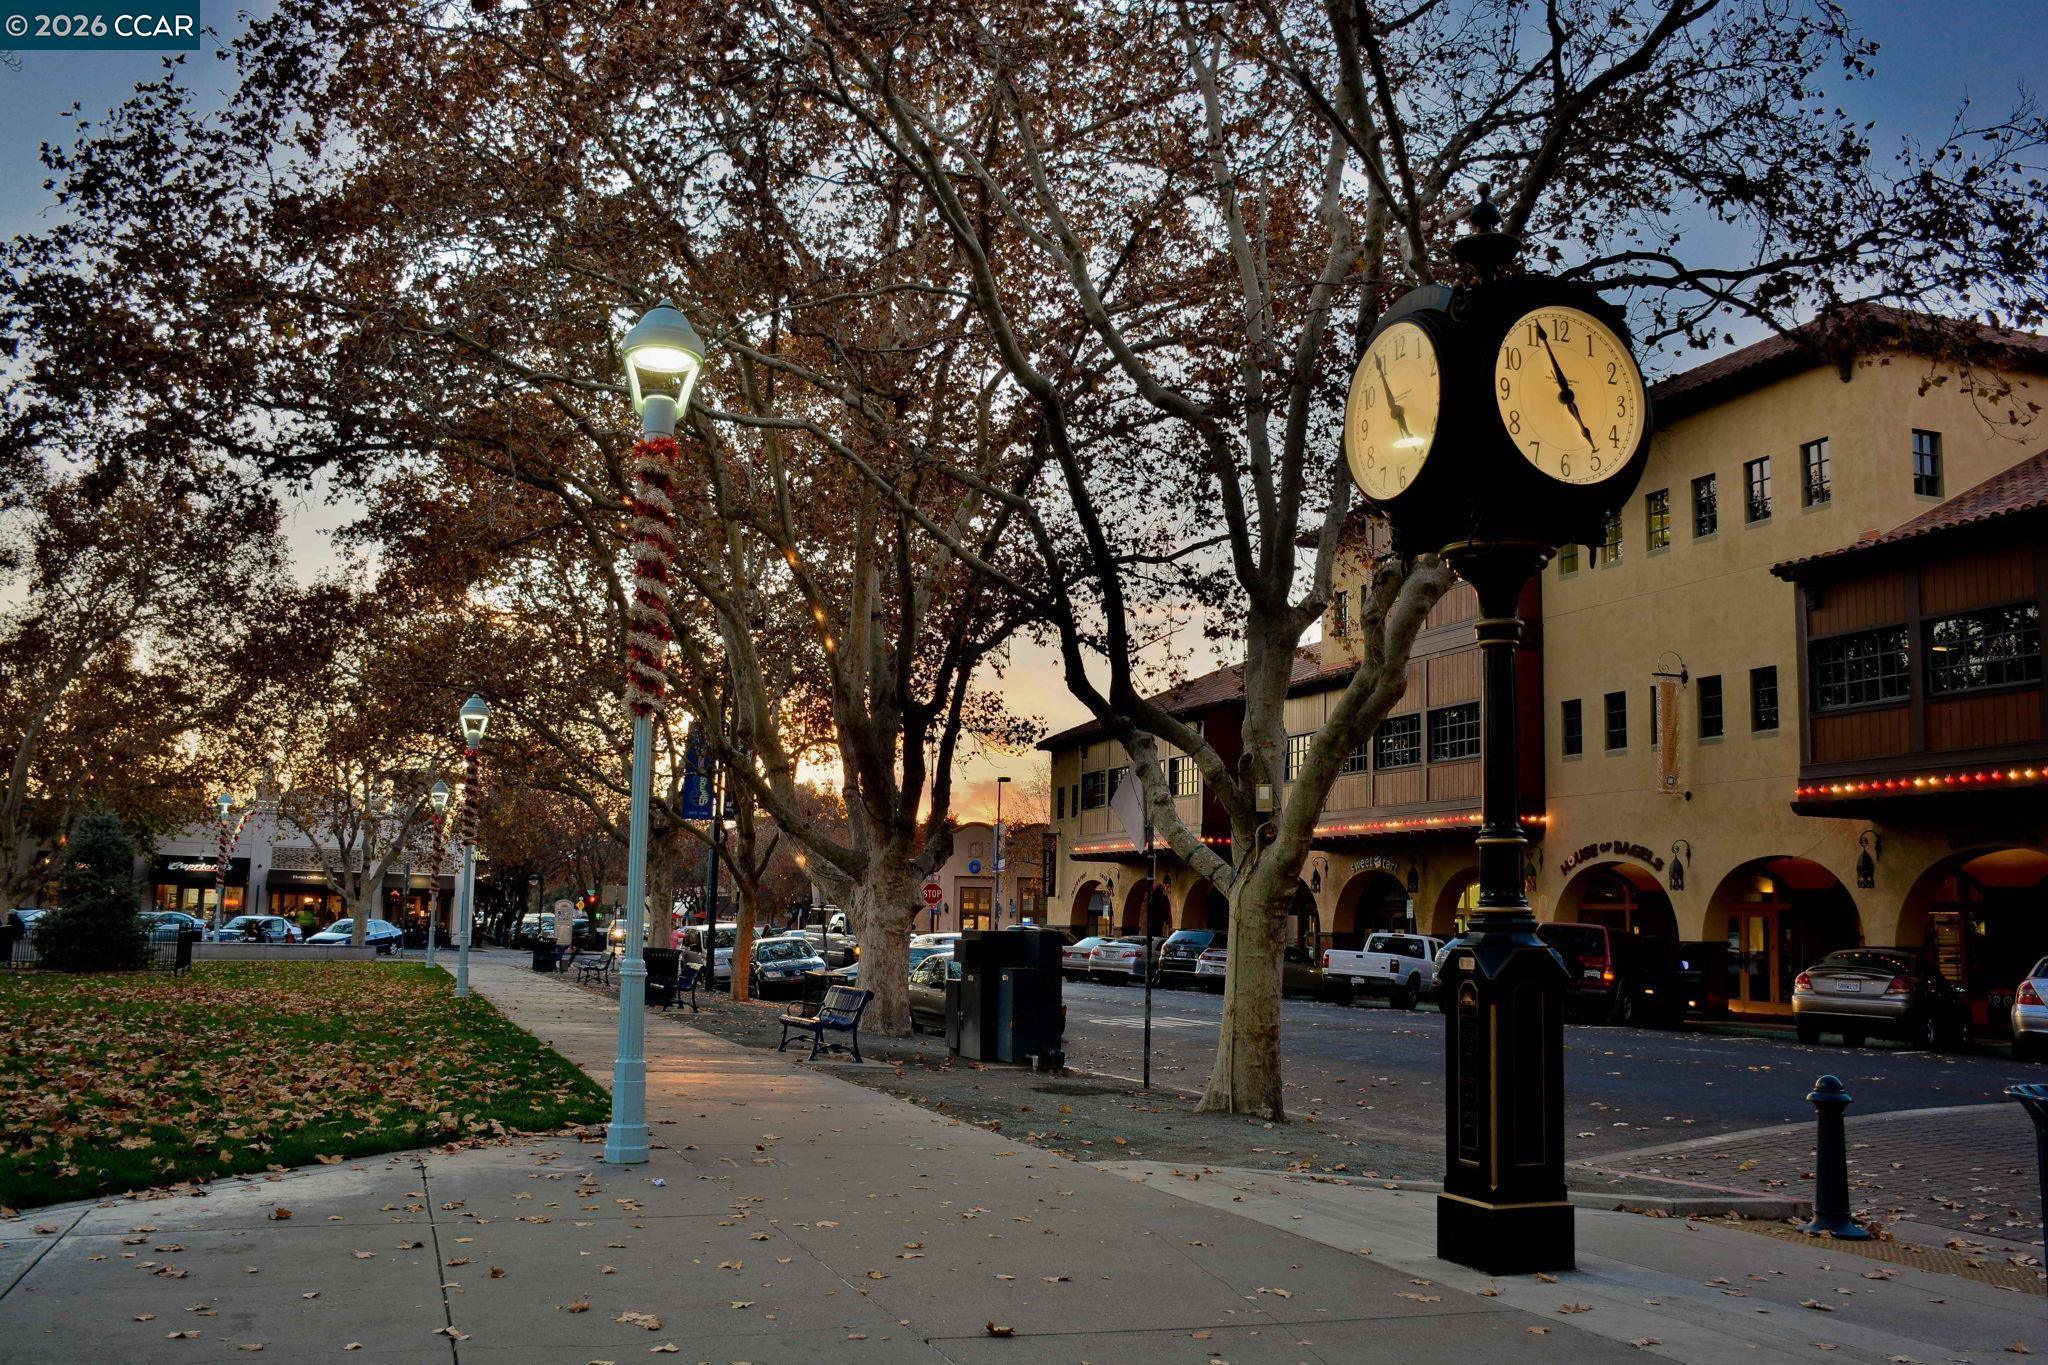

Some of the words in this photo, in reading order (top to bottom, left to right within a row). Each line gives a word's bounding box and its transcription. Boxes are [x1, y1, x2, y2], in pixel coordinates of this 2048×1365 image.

[1552, 319, 1571, 343] 12
[1394, 335, 1406, 361] 12
[1416, 337, 1421, 359] 1
[1586, 334, 1594, 357] 1
[1430, 354, 1437, 378] 2
[1504, 346, 1521, 371] 10
[1606, 362, 1618, 386] 2
[1363, 386, 1376, 410] 10
[1500, 377, 1510, 400] 9
[1616, 395, 1626, 417] 3
[1361, 419, 1368, 441] 9
[1509, 410, 1520, 434] 8
[1608, 425, 1620, 449] 4
[1367, 447, 1375, 469] 8
[1528, 440, 1540, 466] 7
[1560, 453, 1571, 477] 6
[1590, 447, 1601, 471] 5
[1379, 466, 1387, 489] 7
[1399, 466, 1406, 489] 6
[1350, 857, 1373, 874] sweet
[1382, 857, 1398, 874] tart
[1560, 843, 1598, 876] HOUSE
[1614, 841, 1664, 872] BAGELS
[924, 889, 942, 898] STOP
